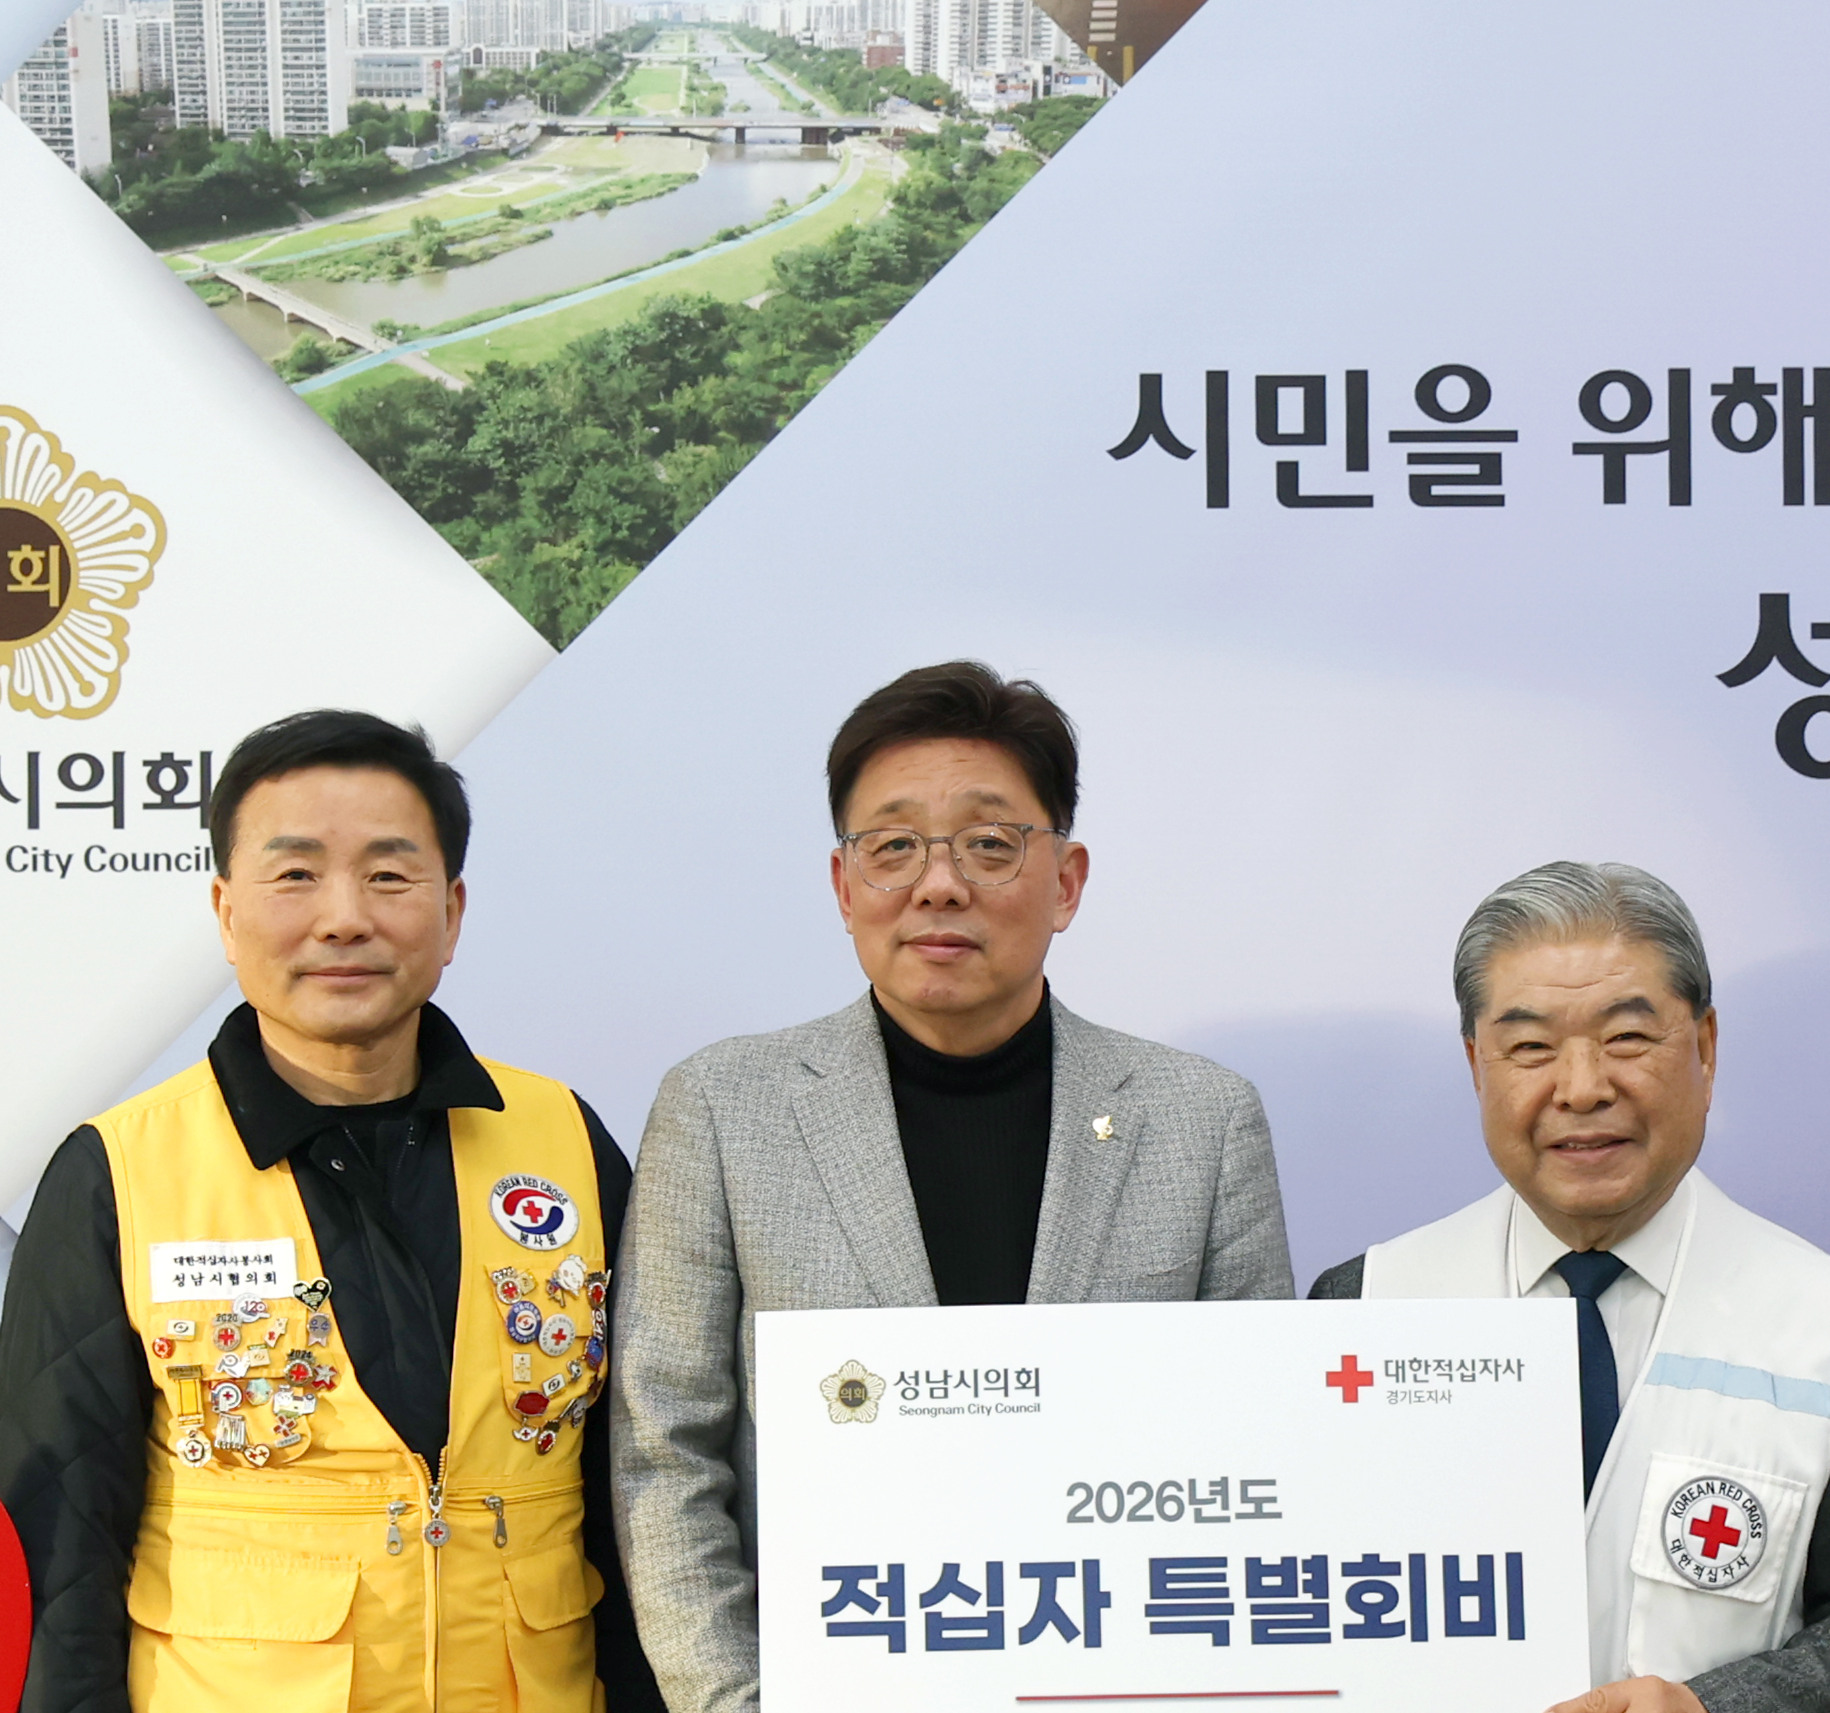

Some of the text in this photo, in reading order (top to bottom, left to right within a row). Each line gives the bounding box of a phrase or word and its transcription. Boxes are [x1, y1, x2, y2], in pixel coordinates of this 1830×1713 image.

[1106, 363, 1519, 510] 시민을
[5, 845, 73, 881] City
[84, 844, 211, 873] Council
[494, 1177, 568, 1206] KOREAN RED CROSS
[173, 1271, 277, 1287] 성남시협의회
[893, 1368, 1040, 1401] 성남시의회
[1383, 1355, 1525, 1385] 대한적십자사
[841, 1388, 866, 1400] 의회
[899, 1403, 1041, 1418] Seongnam City Council
[1386, 1388, 1453, 1405] 경기도지사
[1065, 1477, 1283, 1524] 2026년도
[1672, 1482, 1762, 1540] KOREAN RED CROSS
[1671, 1538, 1750, 1583] 대한적십자사
[820, 1551, 1526, 1654] 적십자 특별회비
